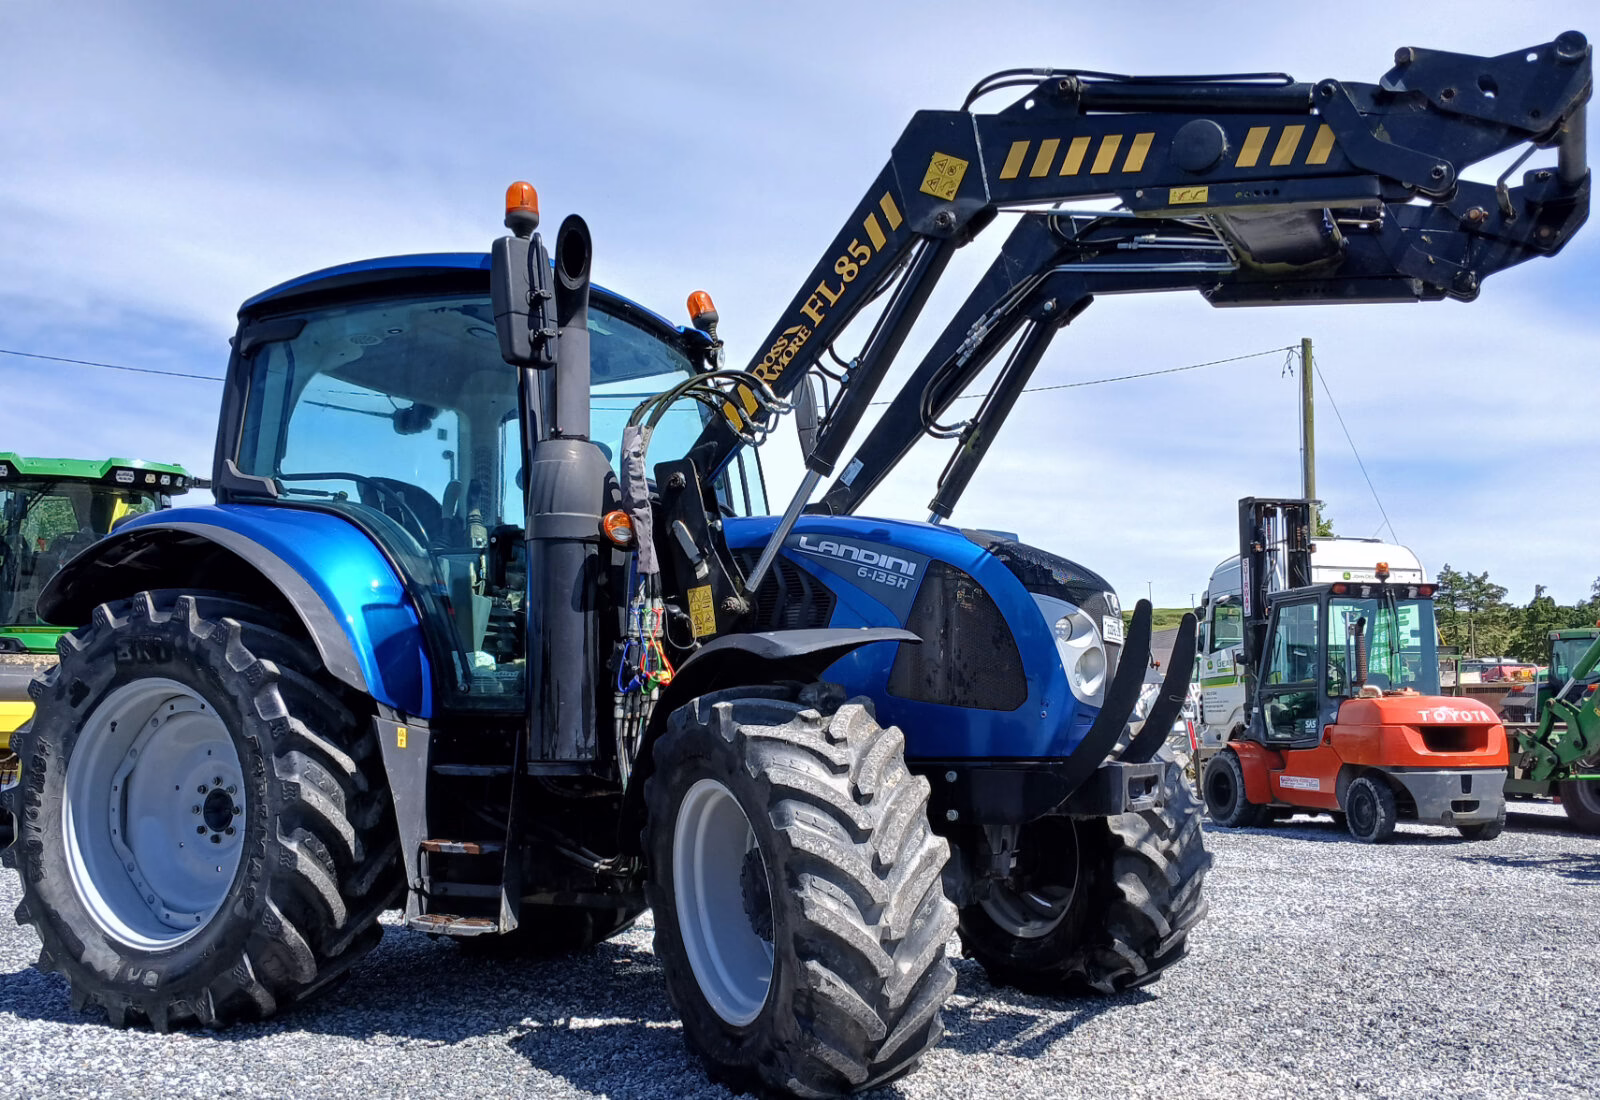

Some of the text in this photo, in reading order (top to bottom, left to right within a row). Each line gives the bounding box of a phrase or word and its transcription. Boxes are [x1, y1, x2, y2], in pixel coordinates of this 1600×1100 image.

[800, 238, 872, 328] FL85
[799, 536, 917, 576] LANDINI
[857, 567, 909, 589] 6-135H
[1417, 710, 1491, 723] TOYOTA
